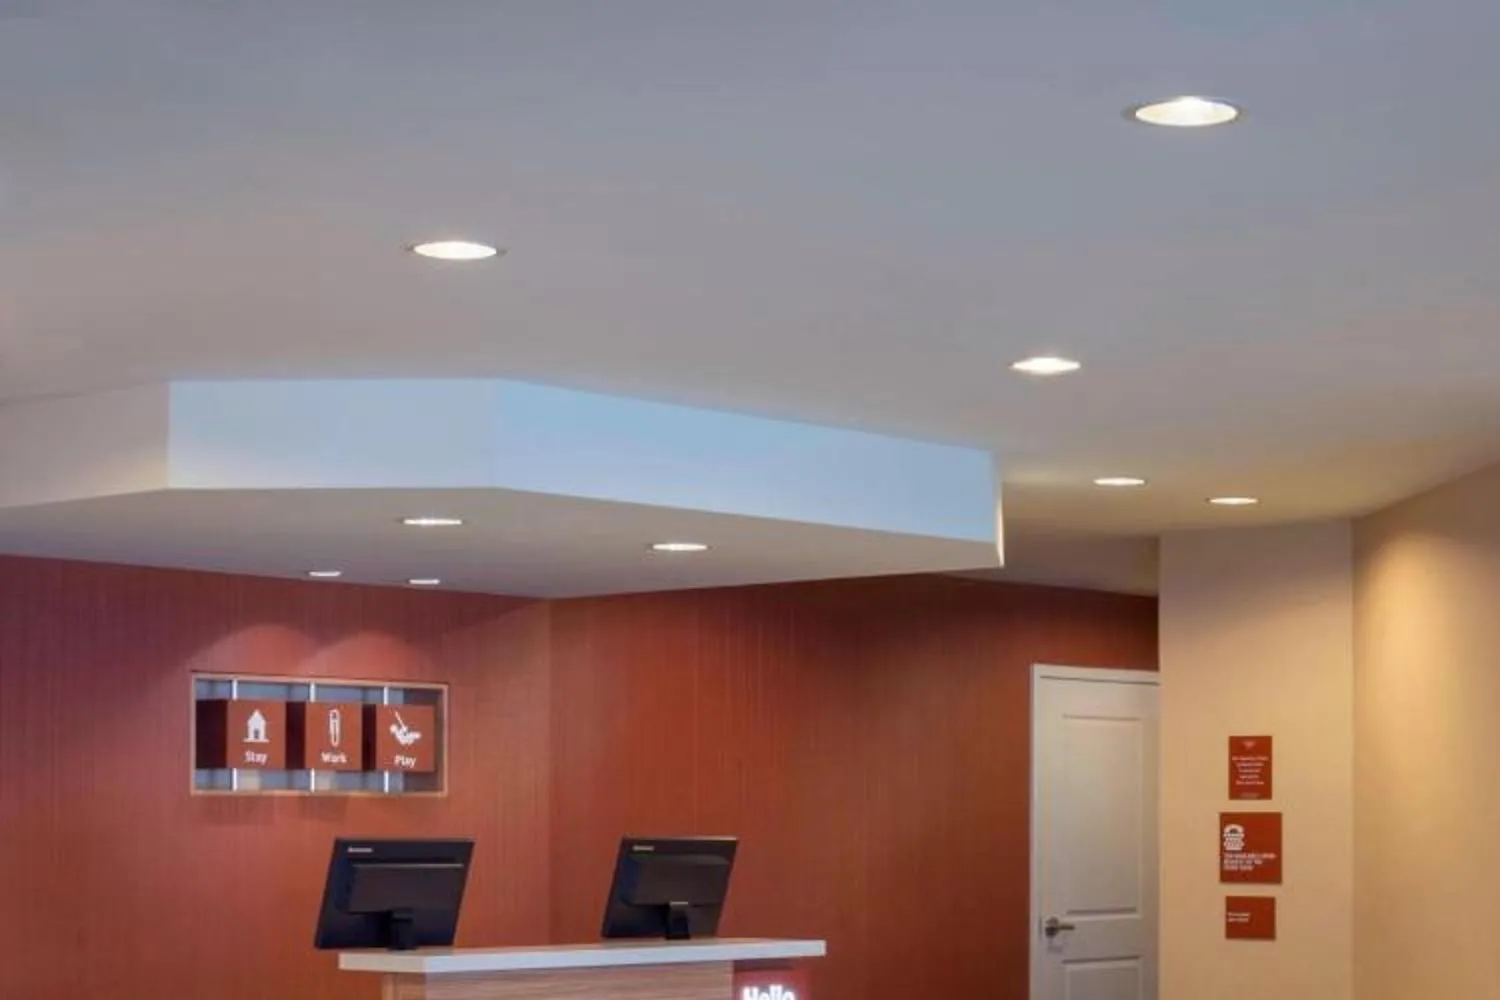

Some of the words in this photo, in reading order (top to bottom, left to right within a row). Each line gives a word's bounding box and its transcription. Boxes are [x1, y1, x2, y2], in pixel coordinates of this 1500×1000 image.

[244, 750, 269, 766] Stay
[320, 750, 348, 764] Work
[393, 754, 417, 768] Play
